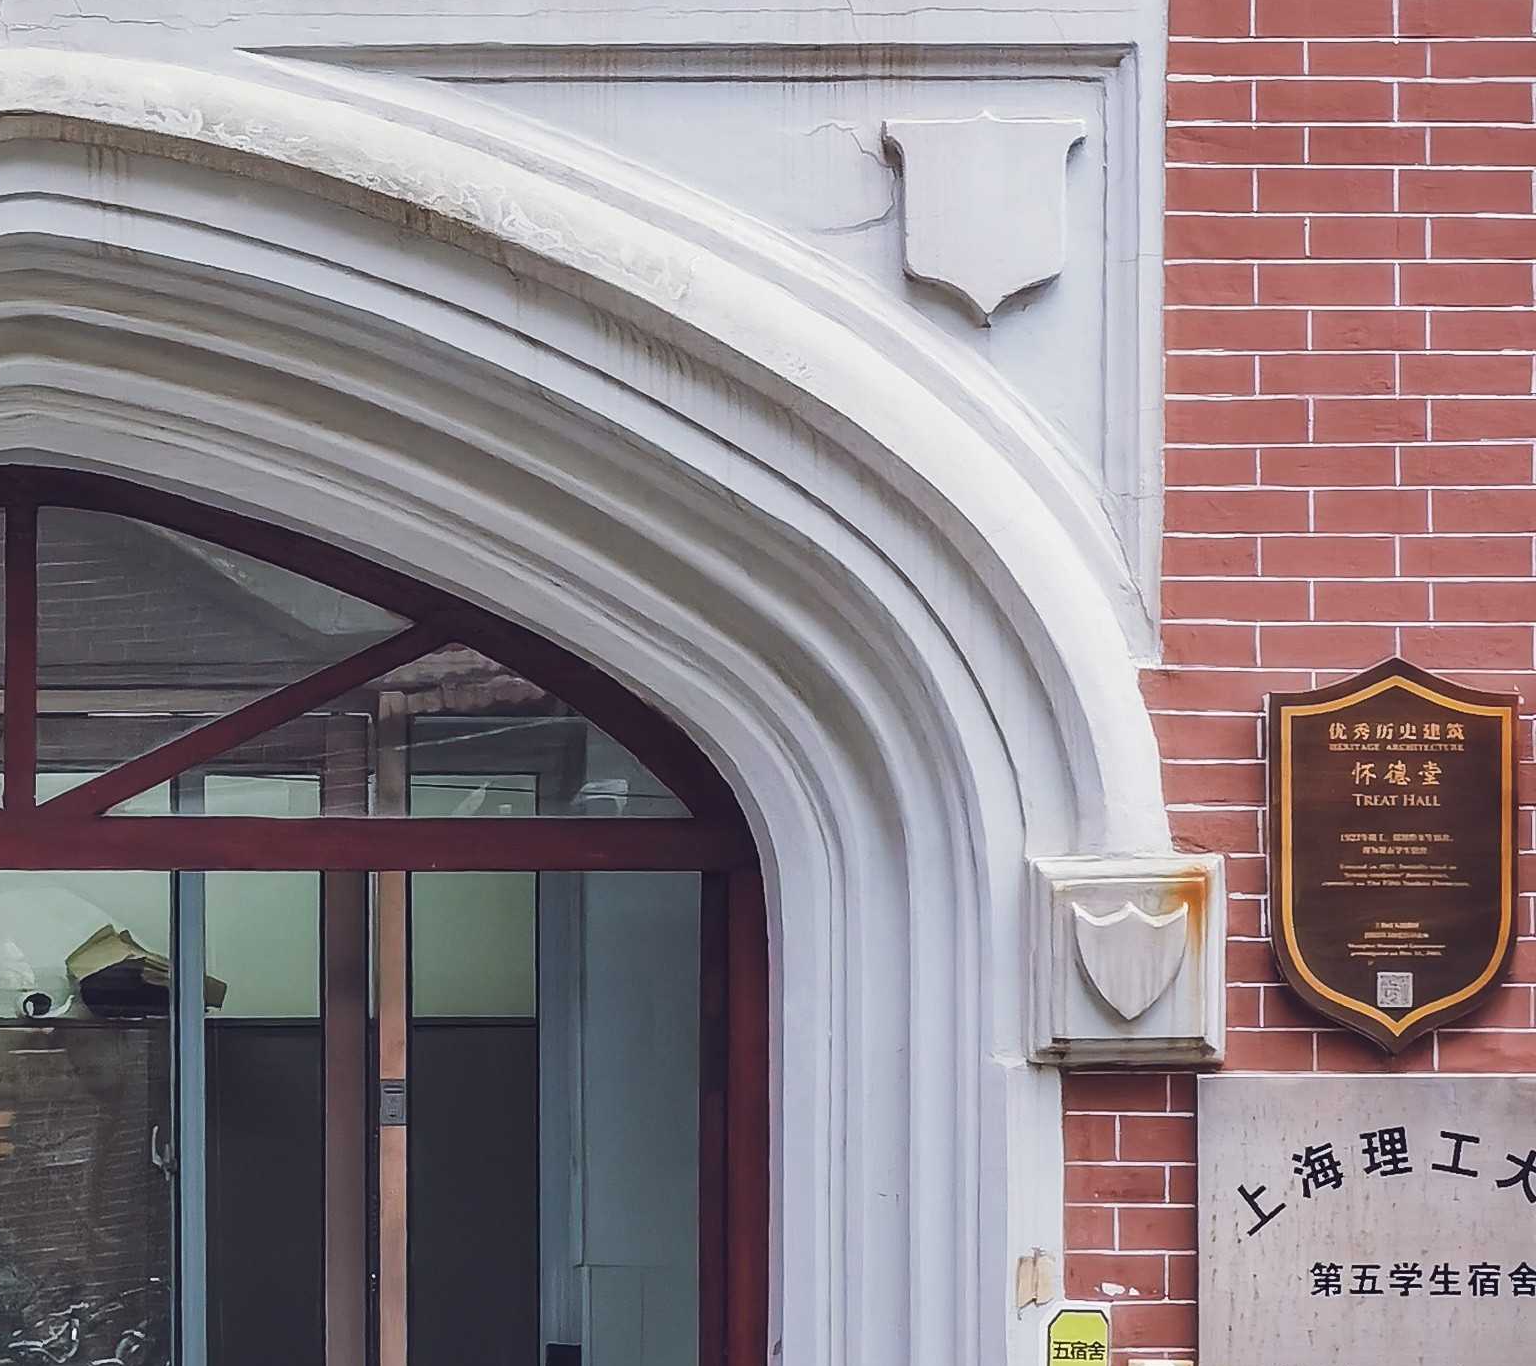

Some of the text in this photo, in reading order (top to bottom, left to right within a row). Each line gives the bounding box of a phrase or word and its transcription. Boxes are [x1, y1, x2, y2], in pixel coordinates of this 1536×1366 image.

[1328, 722, 1465, 741] 优秀历史建筑
[1351, 759, 1443, 786] 怀德堂
[1352, 793, 1441, 807] TREAT HALL
[1237, 1126, 1536, 1237] 上海理工大
[1309, 1261, 1536, 1297] 第五学生宿舍
[1052, 1341, 1106, 1361] 五宿舍
